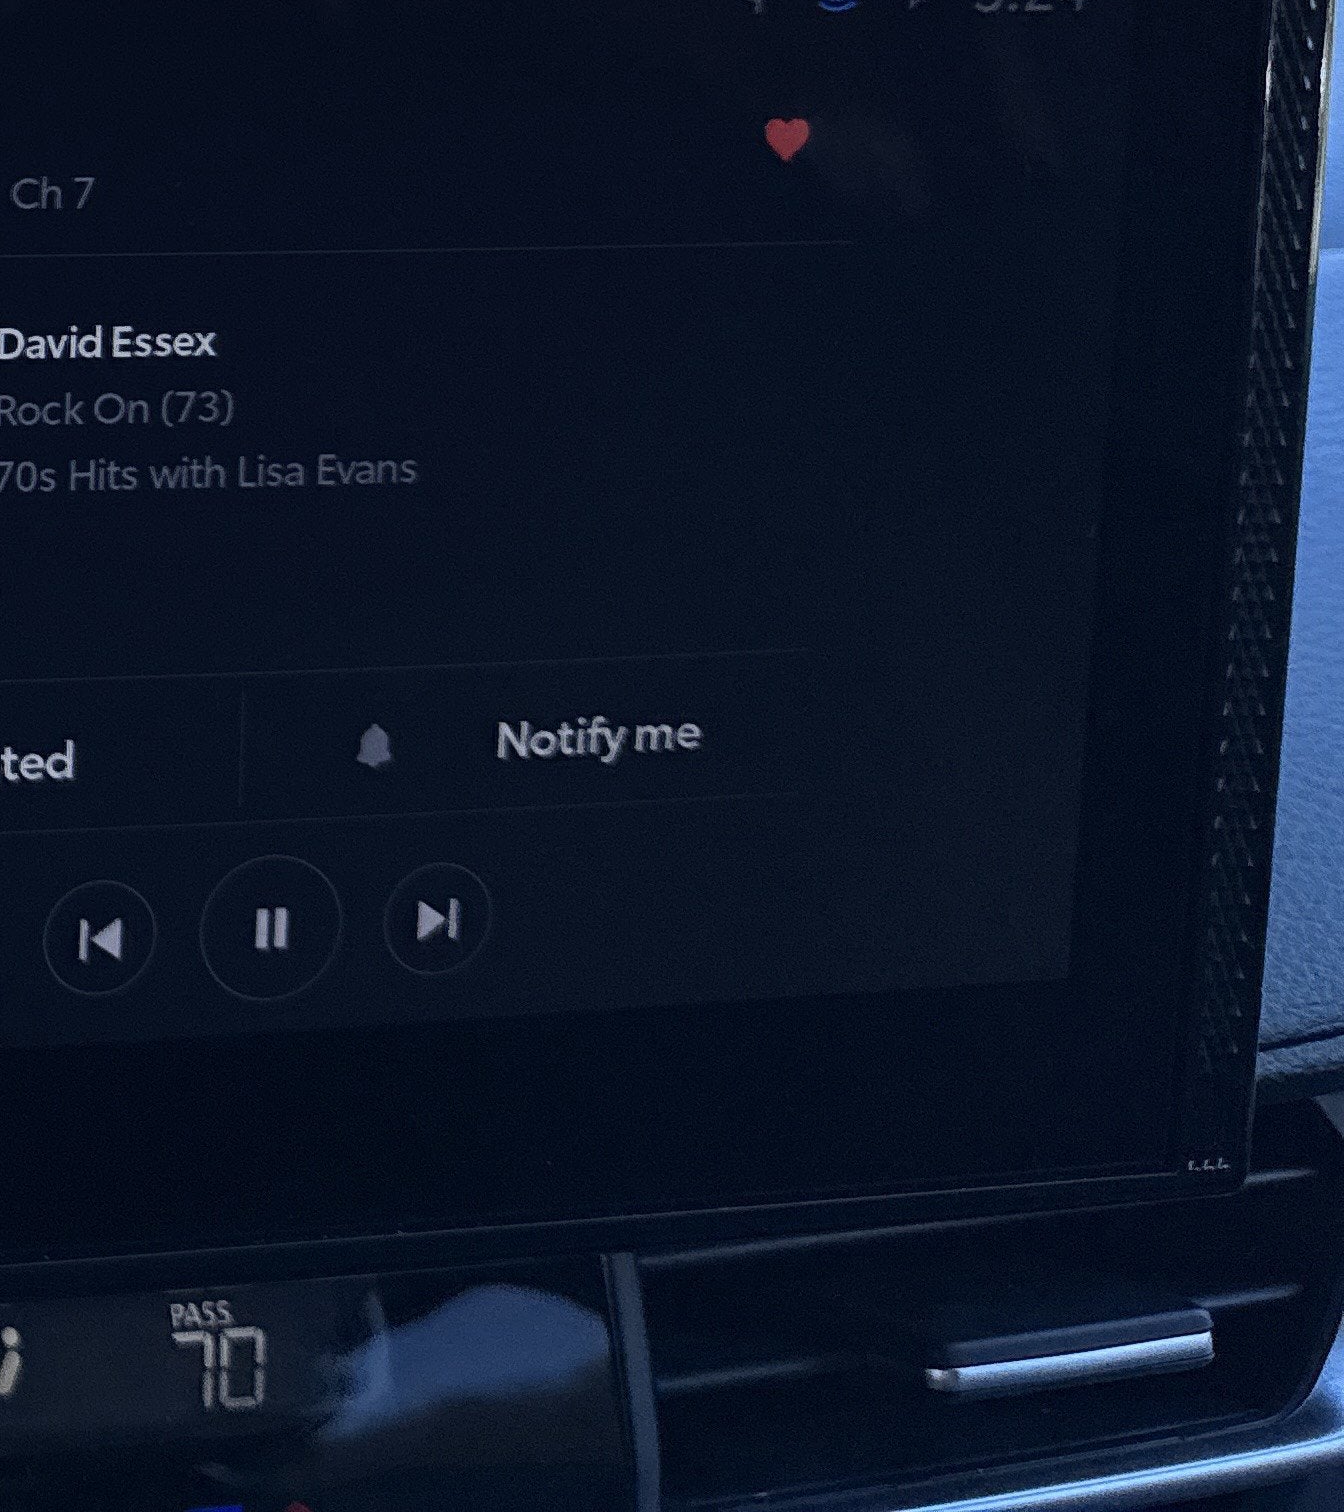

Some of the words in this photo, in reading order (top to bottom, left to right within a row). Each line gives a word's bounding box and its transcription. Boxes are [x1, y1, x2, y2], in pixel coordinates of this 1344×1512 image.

[11, 177, 63, 211] Ch
[74, 177, 95, 211] 7
[112, 326, 217, 358] Essex
[94, 392, 150, 426] On
[160, 389, 235, 429] (73)
[68, 457, 139, 493] Hits
[149, 456, 226, 491] with
[237, 454, 305, 490] Lisa
[315, 453, 419, 486] Evans
[495, 718, 628, 763] Notify
[634, 719, 703, 753] me
[170, 1300, 234, 1329] PASS
[170, 1325, 266, 1408] 70
